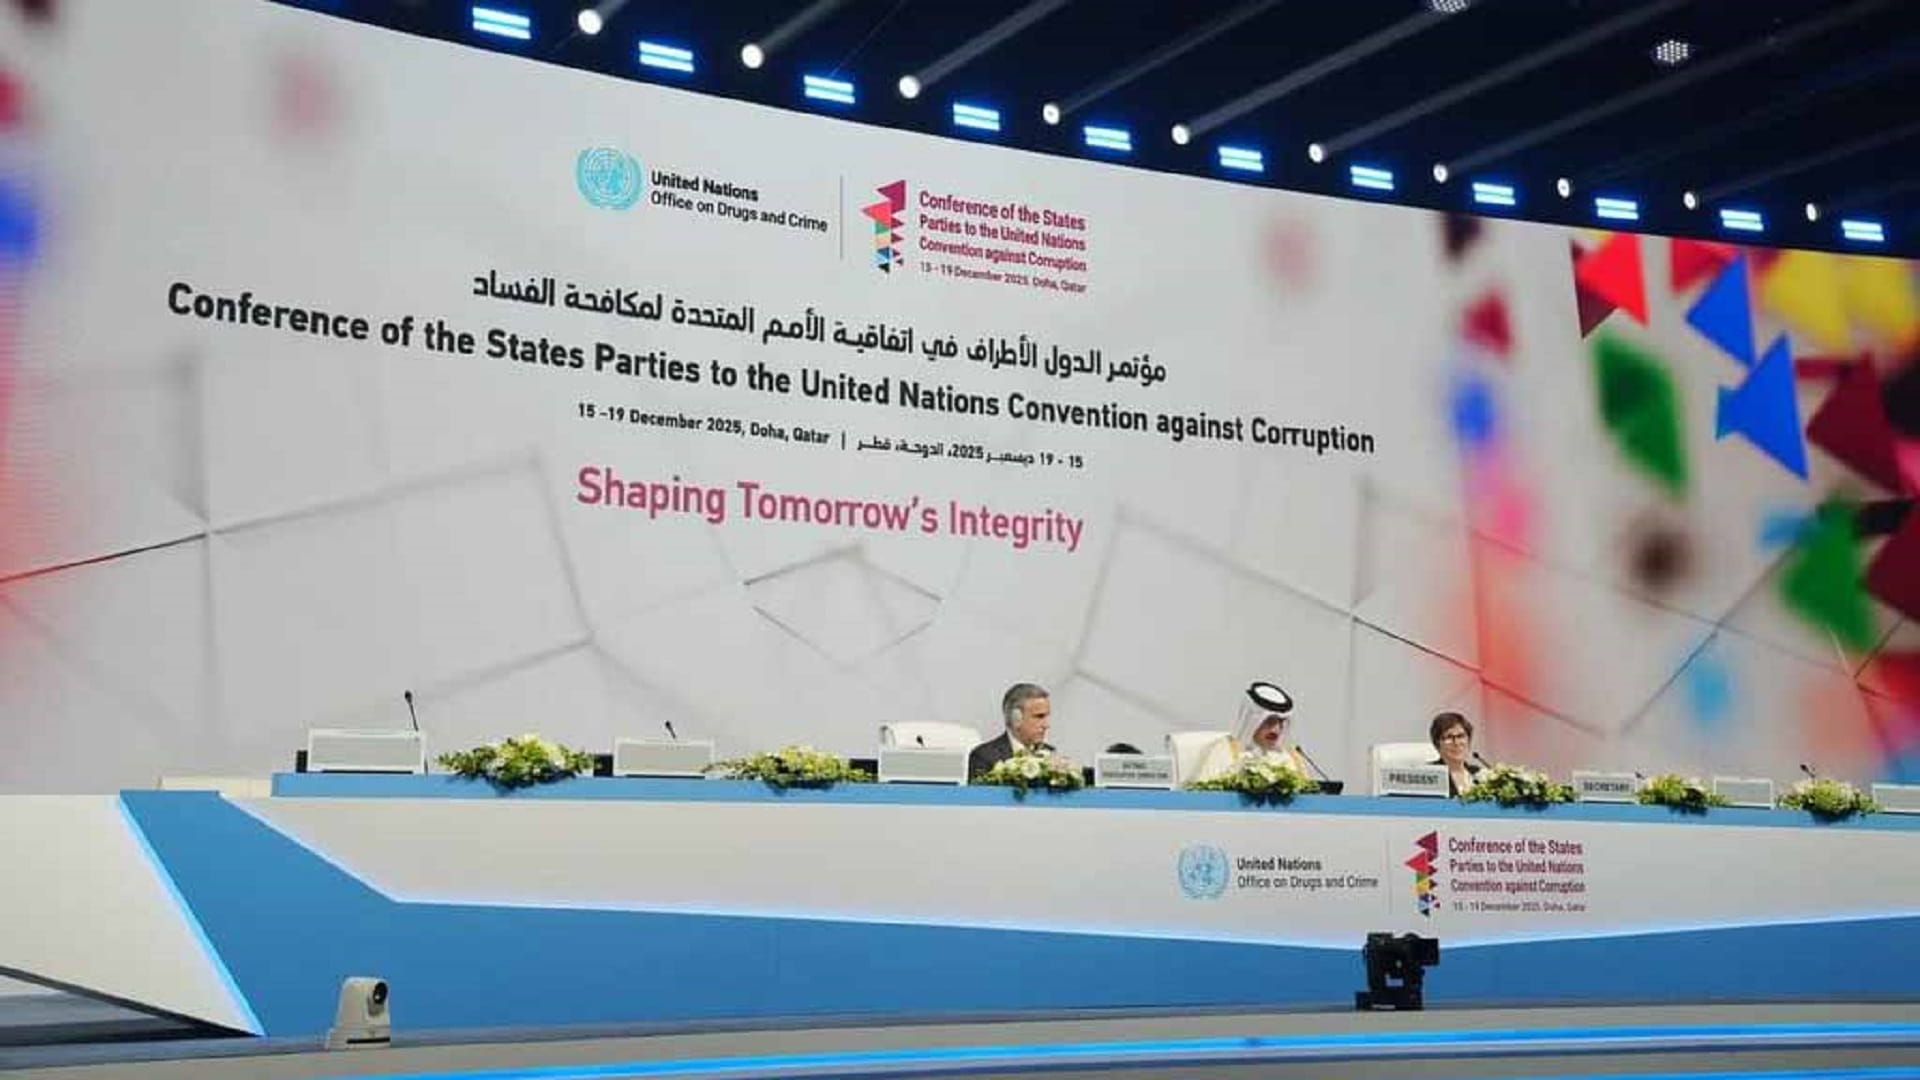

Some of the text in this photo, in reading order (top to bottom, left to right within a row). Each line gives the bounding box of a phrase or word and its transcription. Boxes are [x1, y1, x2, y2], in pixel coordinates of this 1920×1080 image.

[650, 169, 758, 202] United Nations
[650, 190, 828, 232] Office on Drugs and Crime
[919, 190, 1086, 231] Conference of the States
[919, 213, 1086, 251] Parties to the United Nations
[919, 236, 1087, 273] Convention against Corruption
[954, 266, 1002, 281] December
[473, 269, 1166, 386] مؤتمر الدول الأطراف في اتفاقية الأمم المتحدة لمكافحة الفساد
[167, 281, 1375, 455] Conference of the States Parties to the United Nations Convention against Corruption
[578, 402, 595, 418] 15
[629, 408, 703, 430] December
[706, 416, 745, 436] 2025,
[750, 422, 790, 442] Doha,
[793, 428, 831, 444] Qatar
[1039, 451, 1054, 466] 19
[1069, 455, 1084, 469] 15
[577, 467, 726, 524] Shaping
[949, 500, 1085, 552] Integrity
[1388, 772, 1440, 785] PRESIDENT
[1449, 837, 1583, 855] Conference of the States
[1236, 856, 1322, 871] United Nations
[1450, 859, 1584, 875] Parties to the United Nations
[1237, 875, 1379, 891] Office on Drugs and Crime
[1450, 878, 1586, 895] Convention against Corruption
